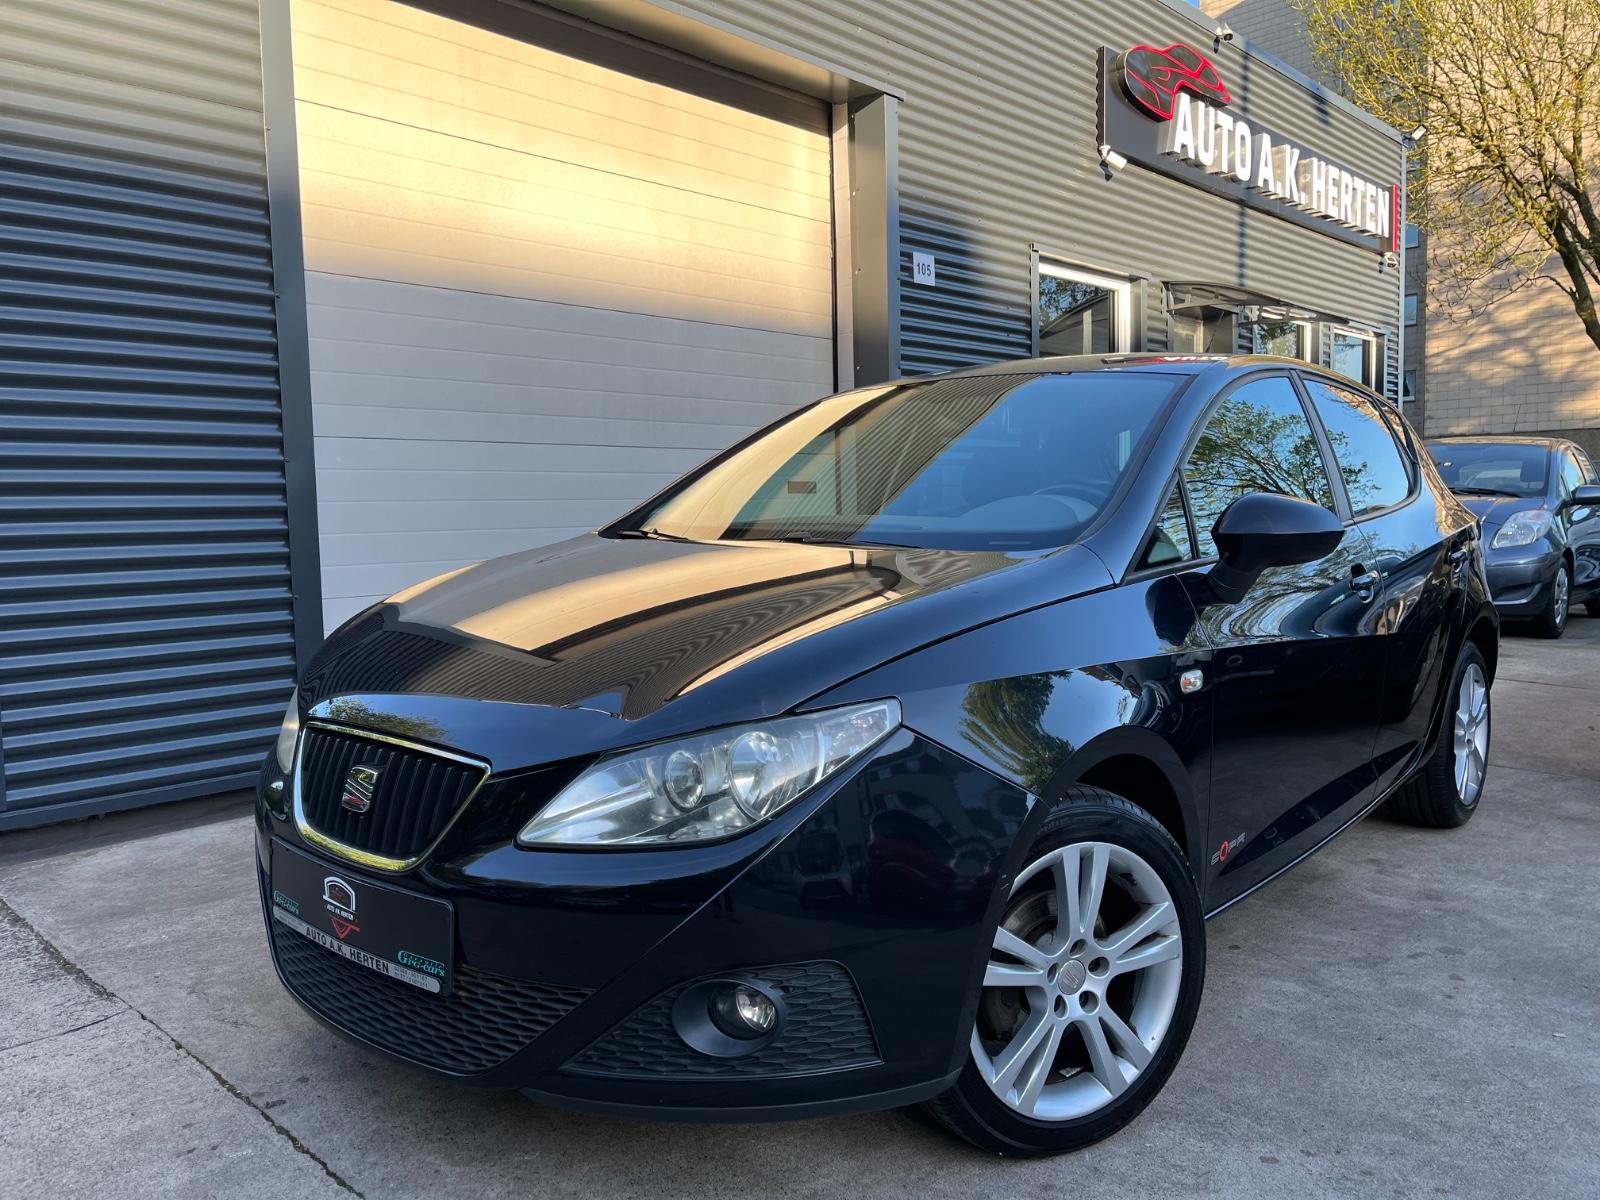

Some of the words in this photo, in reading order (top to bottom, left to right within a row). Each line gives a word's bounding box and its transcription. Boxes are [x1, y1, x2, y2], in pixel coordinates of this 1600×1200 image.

[1173, 91, 1251, 182] AUTO
[1257, 132, 1306, 205] A.K.
[1312, 156, 1390, 238] HERTEN
[917, 262, 932, 276] 105
[306, 926, 327, 946] AUTO
[329, 939, 347, 957] A.K.
[349, 947, 390, 975] HERTEN
